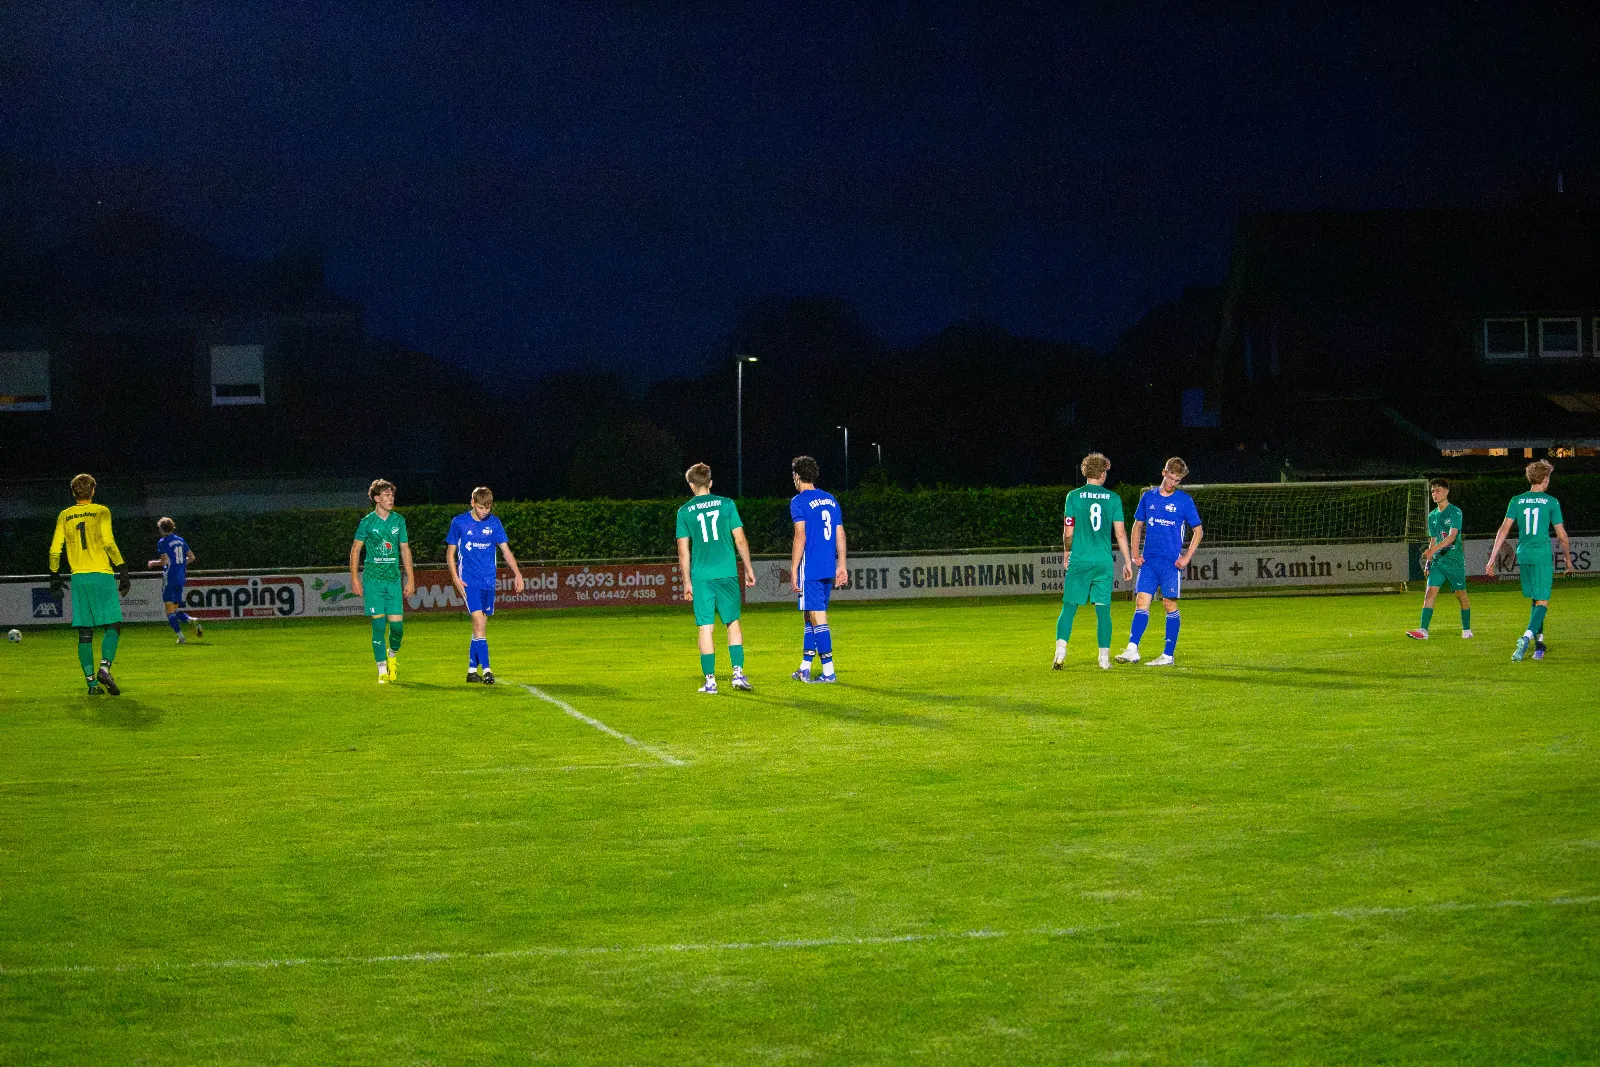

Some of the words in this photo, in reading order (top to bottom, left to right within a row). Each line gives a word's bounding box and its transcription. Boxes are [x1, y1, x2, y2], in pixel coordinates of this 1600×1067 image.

[696, 510, 720, 543] 17
[821, 509, 832, 541] 3
[1065, 517, 1073, 526] C
[1090, 503, 1102, 532] 8
[1523, 507, 1540, 535] 11
[76, 521, 88, 551] 1
[565, 573, 614, 588] 49393
[618, 571, 666, 587] Lohne
[899, 563, 1035, 590] SCHLARMANN
[1256, 555, 1333, 579] Kamin
[1347, 559, 1393, 572] Lohne
[183, 580, 296, 617] amping
[575, 591, 590, 600] Tel.
[632, 589, 656, 599] 4358
[33, 603, 58, 616] AXA
